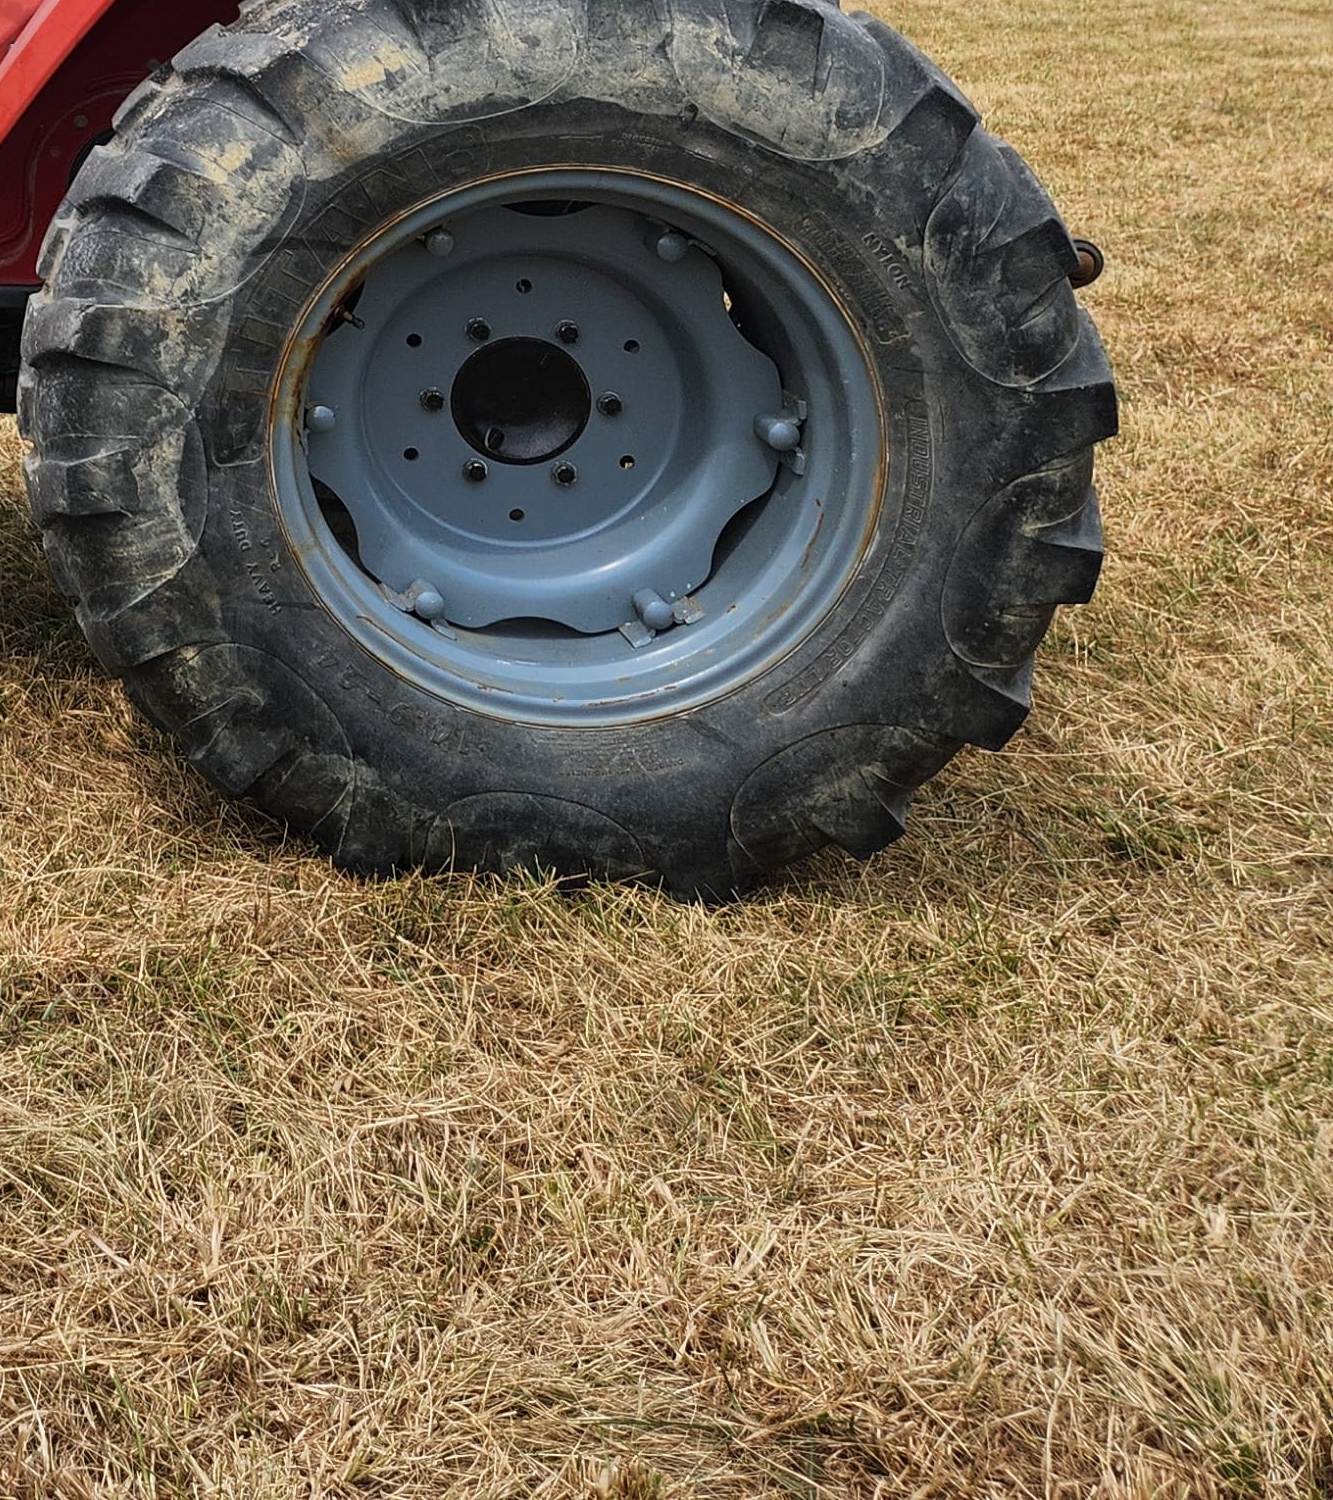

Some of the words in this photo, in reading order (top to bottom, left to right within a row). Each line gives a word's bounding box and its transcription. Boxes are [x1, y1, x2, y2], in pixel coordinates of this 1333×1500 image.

[861, 231, 914, 290] NYLON
[889, 415, 928, 562] INDUSTRIAL
[230, 509, 251, 552] DUTY
[246, 562, 282, 616] HEAVY
[830, 566, 904, 669] TRACTOR
